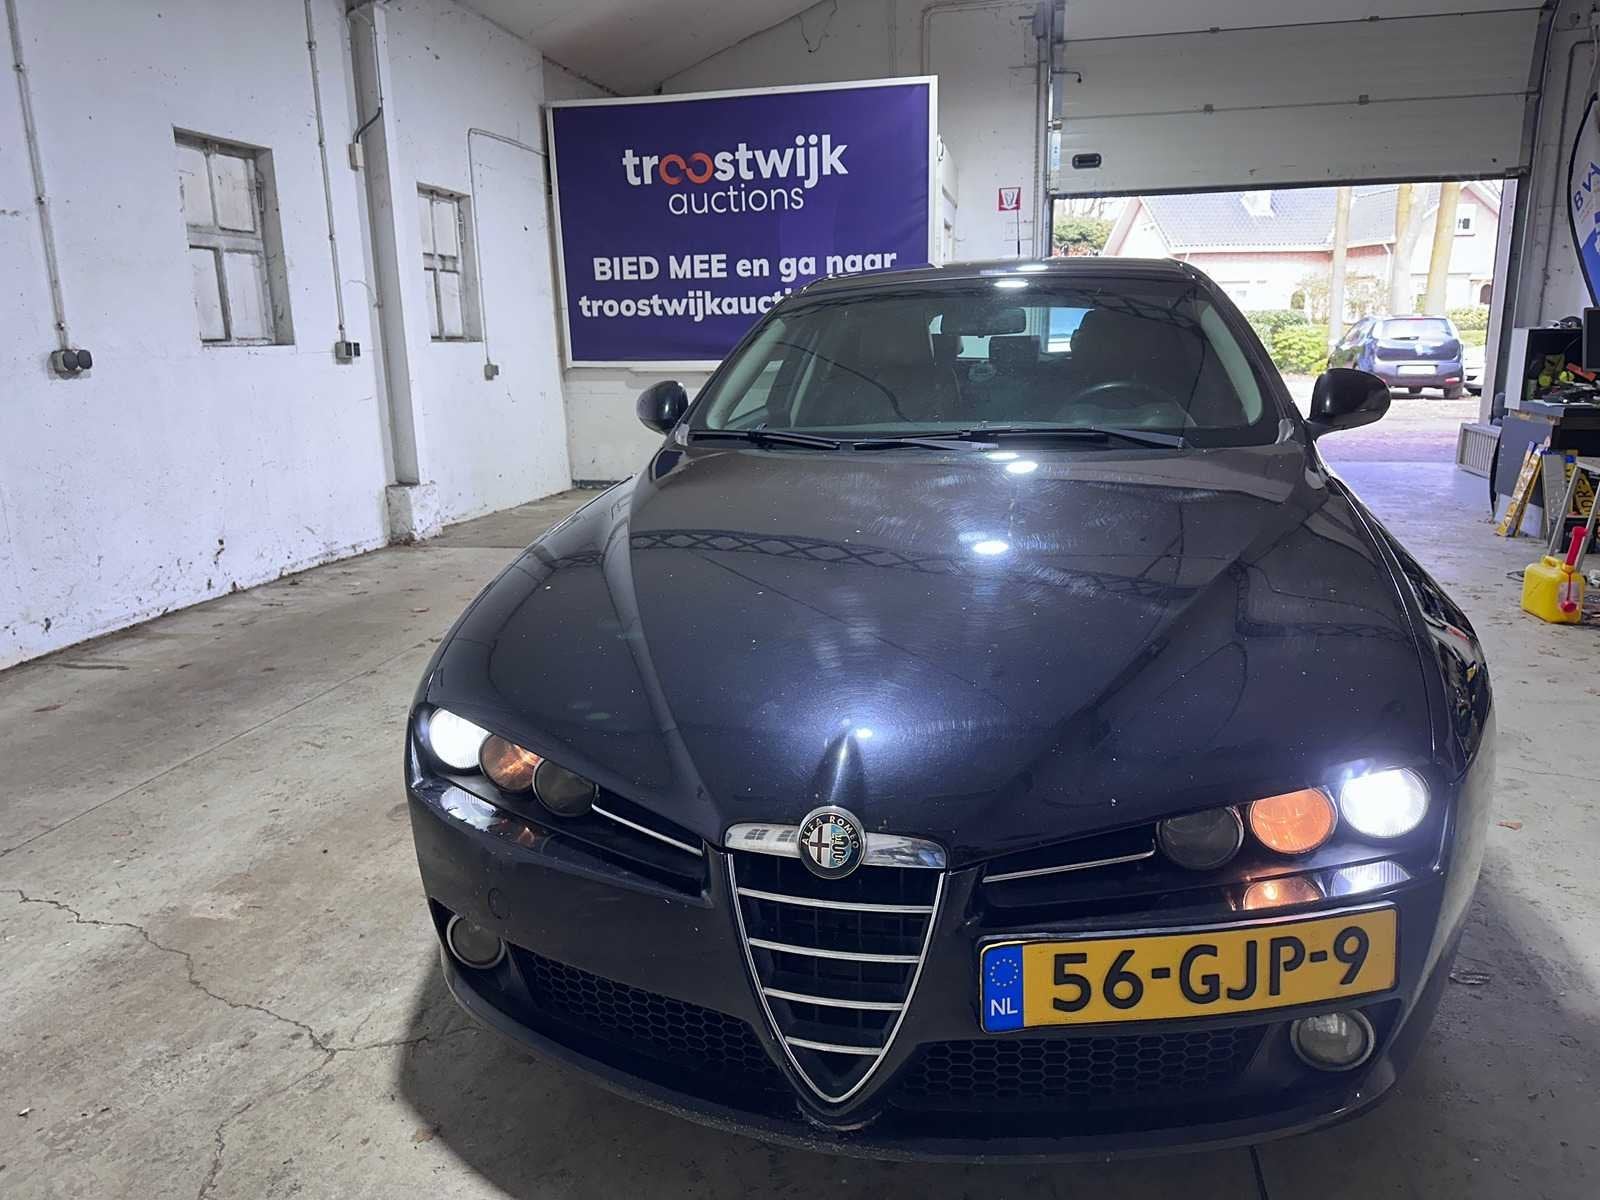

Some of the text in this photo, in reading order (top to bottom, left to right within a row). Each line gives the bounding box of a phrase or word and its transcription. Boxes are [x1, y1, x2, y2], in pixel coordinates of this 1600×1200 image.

[622, 134, 849, 188] troostwijk
[668, 183, 805, 215] auctions
[593, 252, 897, 282] BIED MEE en ga naar
[801, 815, 860, 849] ALFA ROMEO
[1052, 925, 1370, 1013] 56-GJP-9
[990, 998, 1018, 1017] NL
